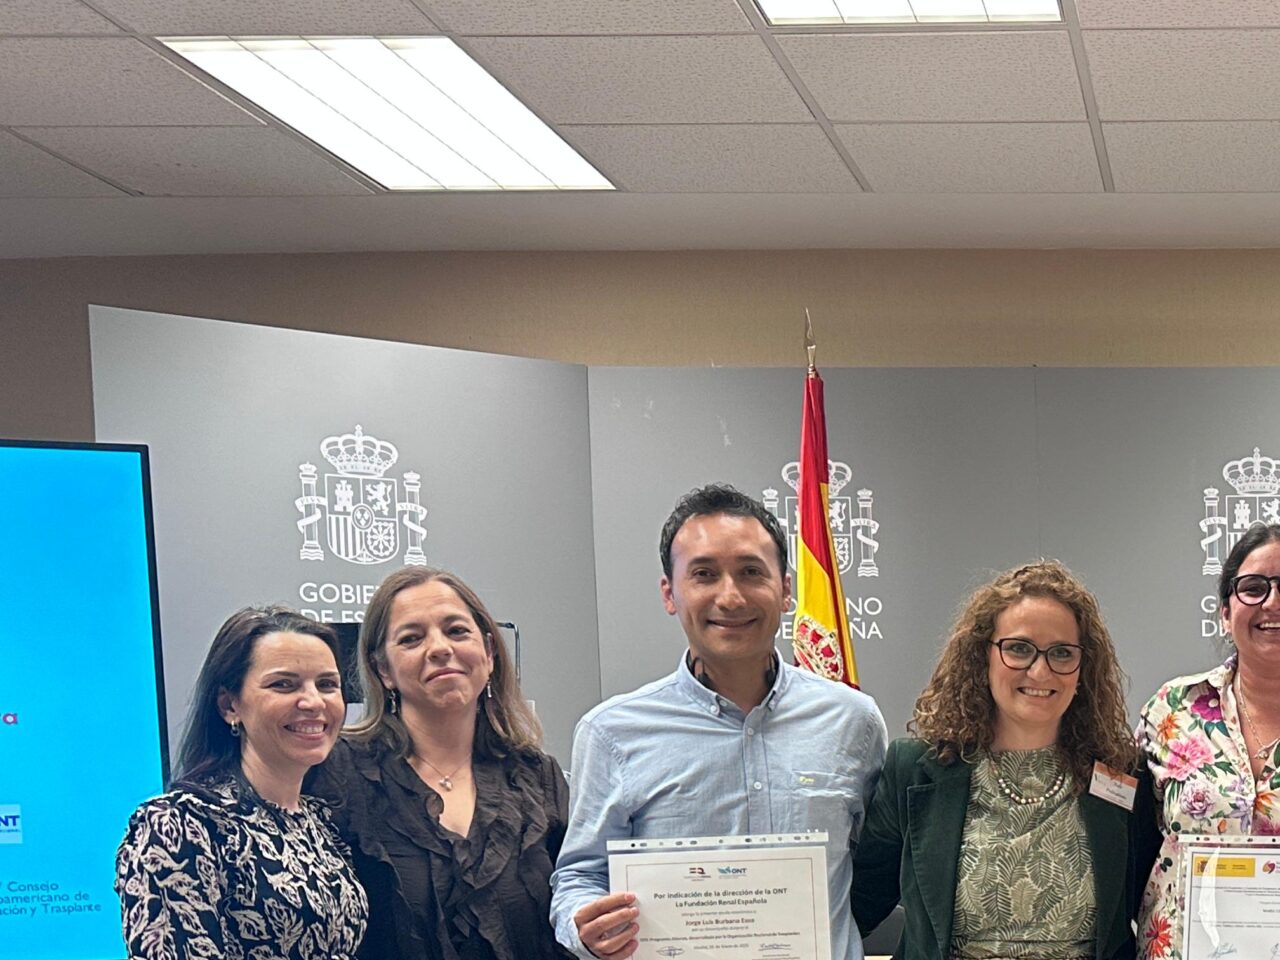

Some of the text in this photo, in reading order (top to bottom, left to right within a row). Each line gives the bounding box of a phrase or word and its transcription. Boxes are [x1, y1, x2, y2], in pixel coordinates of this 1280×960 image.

[299, 582, 380, 604] GOBIE
[7, 880, 59, 893] Consejo
[0, 891, 90, 904] americano de
[653, 892, 665, 900] Por
[667, 891, 703, 899] indicación
[703, 889, 713, 898] de
[713, 890, 721, 898] la
[722, 888, 753, 897] dirección
[754, 888, 764, 896] de
[772, 887, 787, 895] ONT
[684, 899, 718, 907] Fundación
[718, 898, 736, 906] Renal
[737, 897, 768, 906] Española
[30, 906, 37, 918] y
[41, 903, 102, 916] Trasplante
